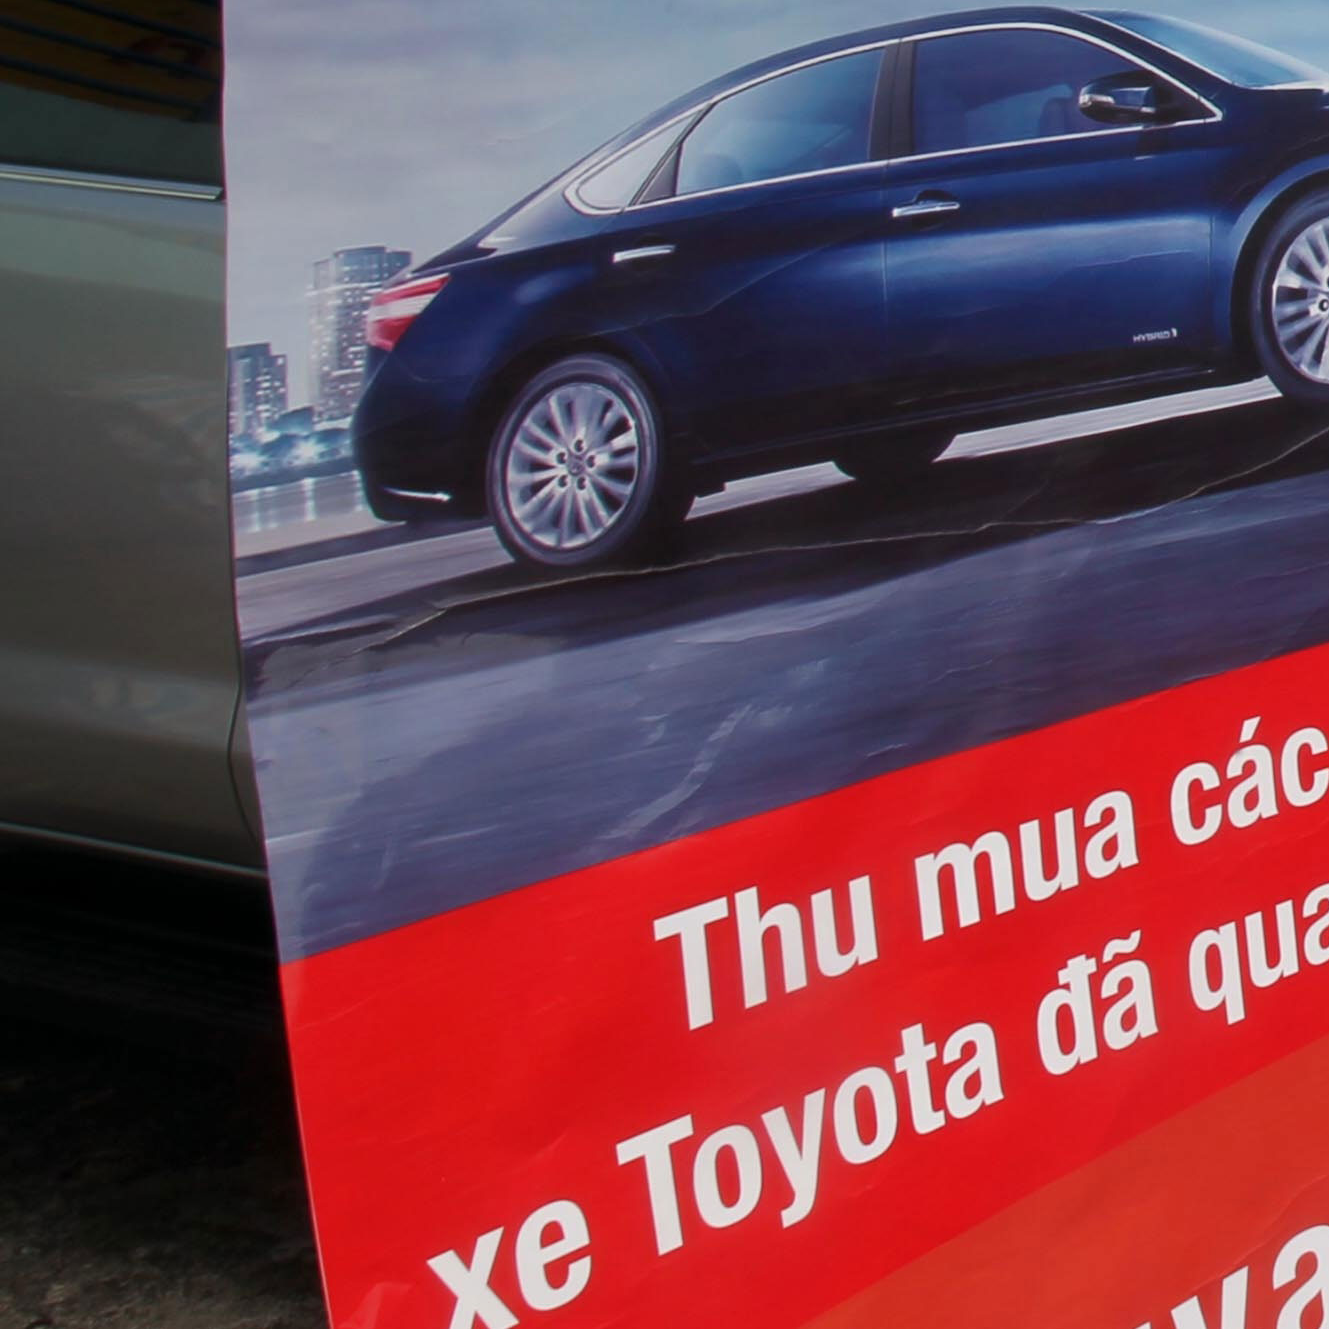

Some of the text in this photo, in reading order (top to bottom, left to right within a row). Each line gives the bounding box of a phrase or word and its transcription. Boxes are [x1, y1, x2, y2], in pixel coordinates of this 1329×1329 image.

[654, 875, 878, 1030] Thu
[914, 790, 1141, 942] mua
[426, 1195, 593, 1329] xe
[616, 1021, 1005, 1257] Toyota
[1037, 930, 1158, 1075] đã
